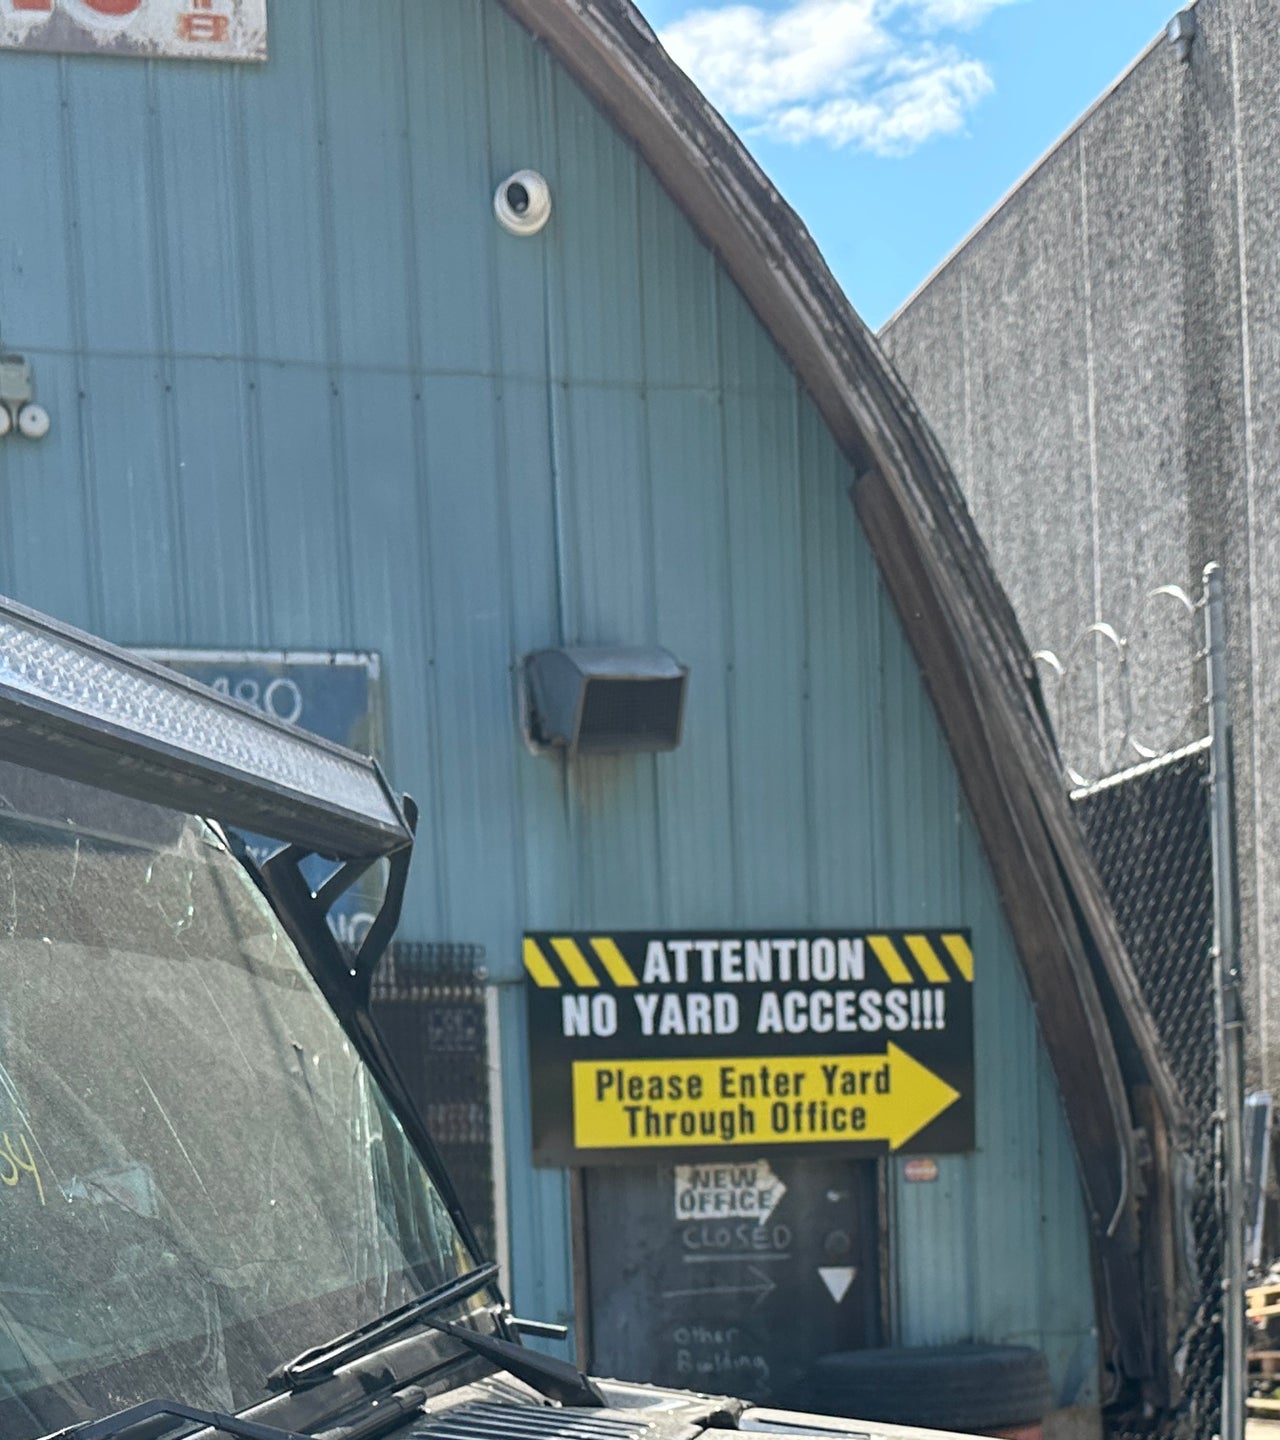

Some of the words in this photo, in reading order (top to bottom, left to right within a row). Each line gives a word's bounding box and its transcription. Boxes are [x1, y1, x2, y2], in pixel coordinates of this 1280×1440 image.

[642, 937, 865, 985] ATTENTION
[562, 993, 617, 1038] NO
[634, 991, 739, 1036] YARD
[756, 989, 946, 1033] ACCESS!!!
[595, 1067, 702, 1102] Please
[719, 1065, 806, 1099] Enter
[821, 1062, 891, 1096] Yard
[623, 1102, 755, 1141] Through
[770, 1100, 867, 1134] Office
[691, 1168, 758, 1189] NEW
[679, 1189, 772, 1212] OFFICE
[682, 1223, 793, 1251] CLOSED
